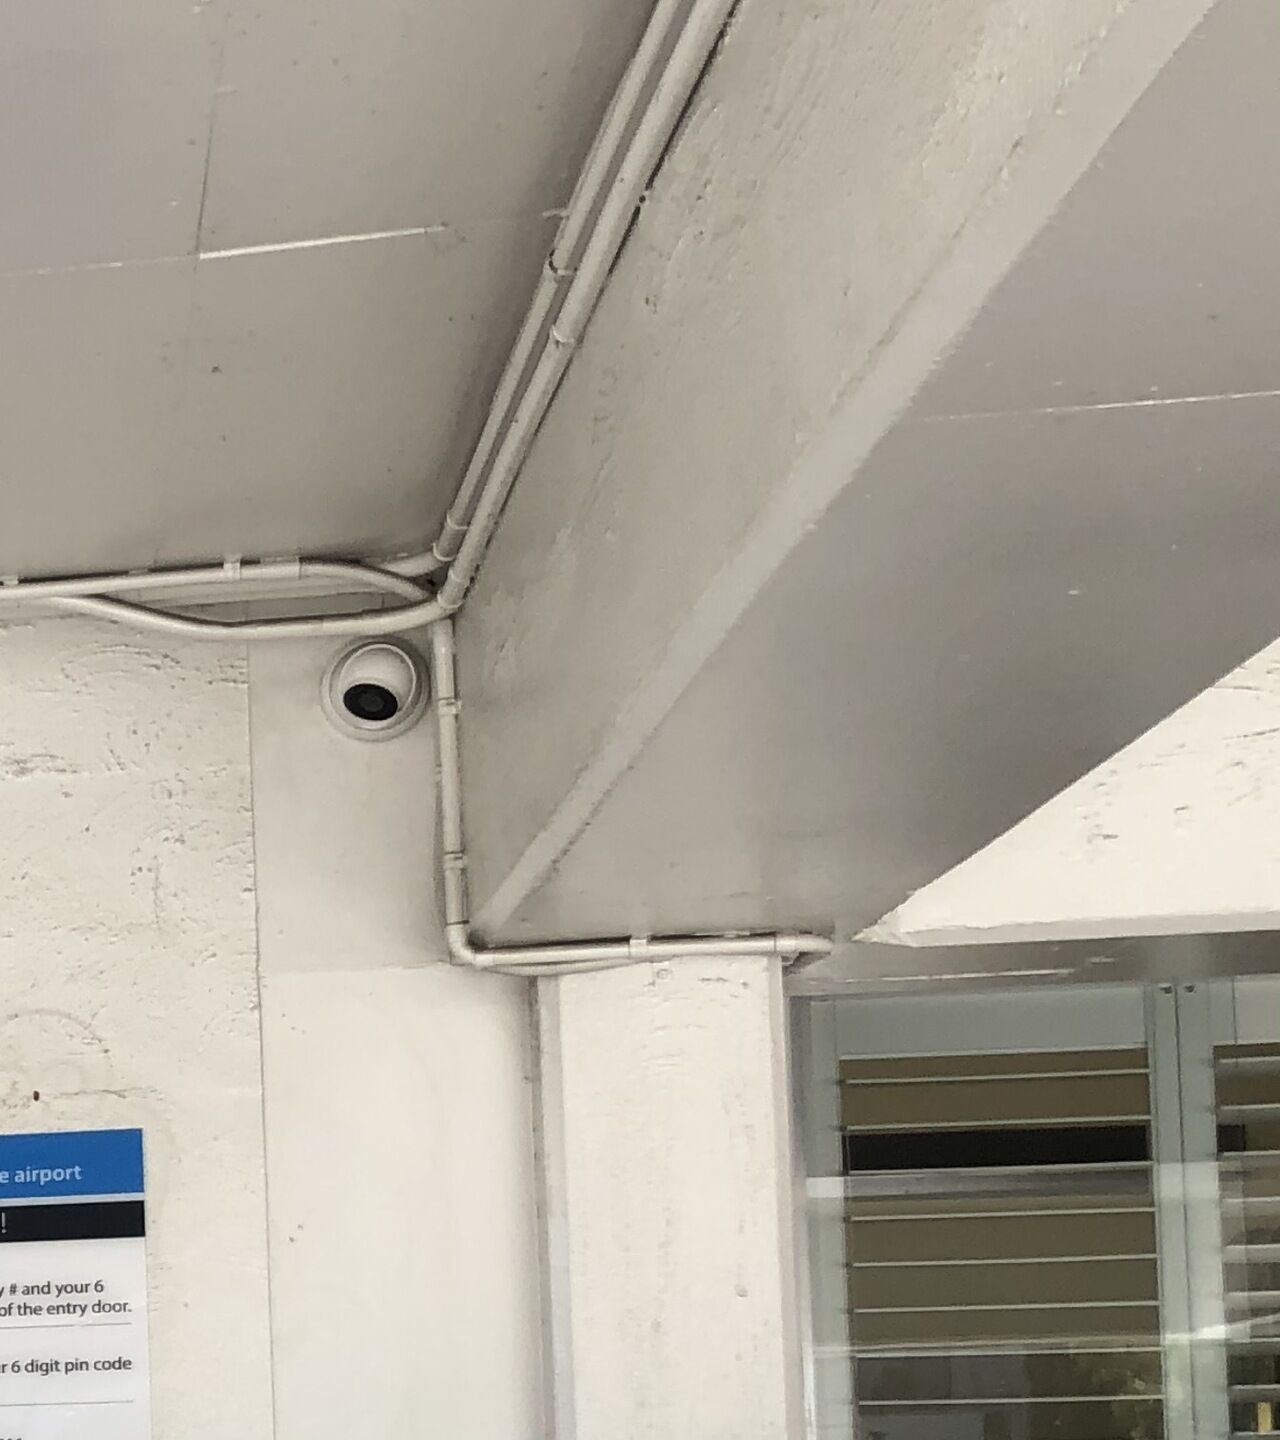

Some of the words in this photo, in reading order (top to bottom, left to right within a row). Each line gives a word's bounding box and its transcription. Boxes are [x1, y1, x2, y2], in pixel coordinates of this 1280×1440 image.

[14, 1165, 82, 1185] airport
[9, 1283, 17, 1295] #
[21, 1281, 51, 1295] and
[55, 1281, 91, 1297] your
[94, 1280, 104, 1293] 6
[17, 1302, 43, 1316] the
[46, 1302, 87, 1316] entry
[92, 1300, 132, 1314] door.
[11, 1361, 20, 1373] 6
[24, 1359, 60, 1376] digit
[65, 1357, 89, 1374] pin
[94, 1357, 132, 1371] code
